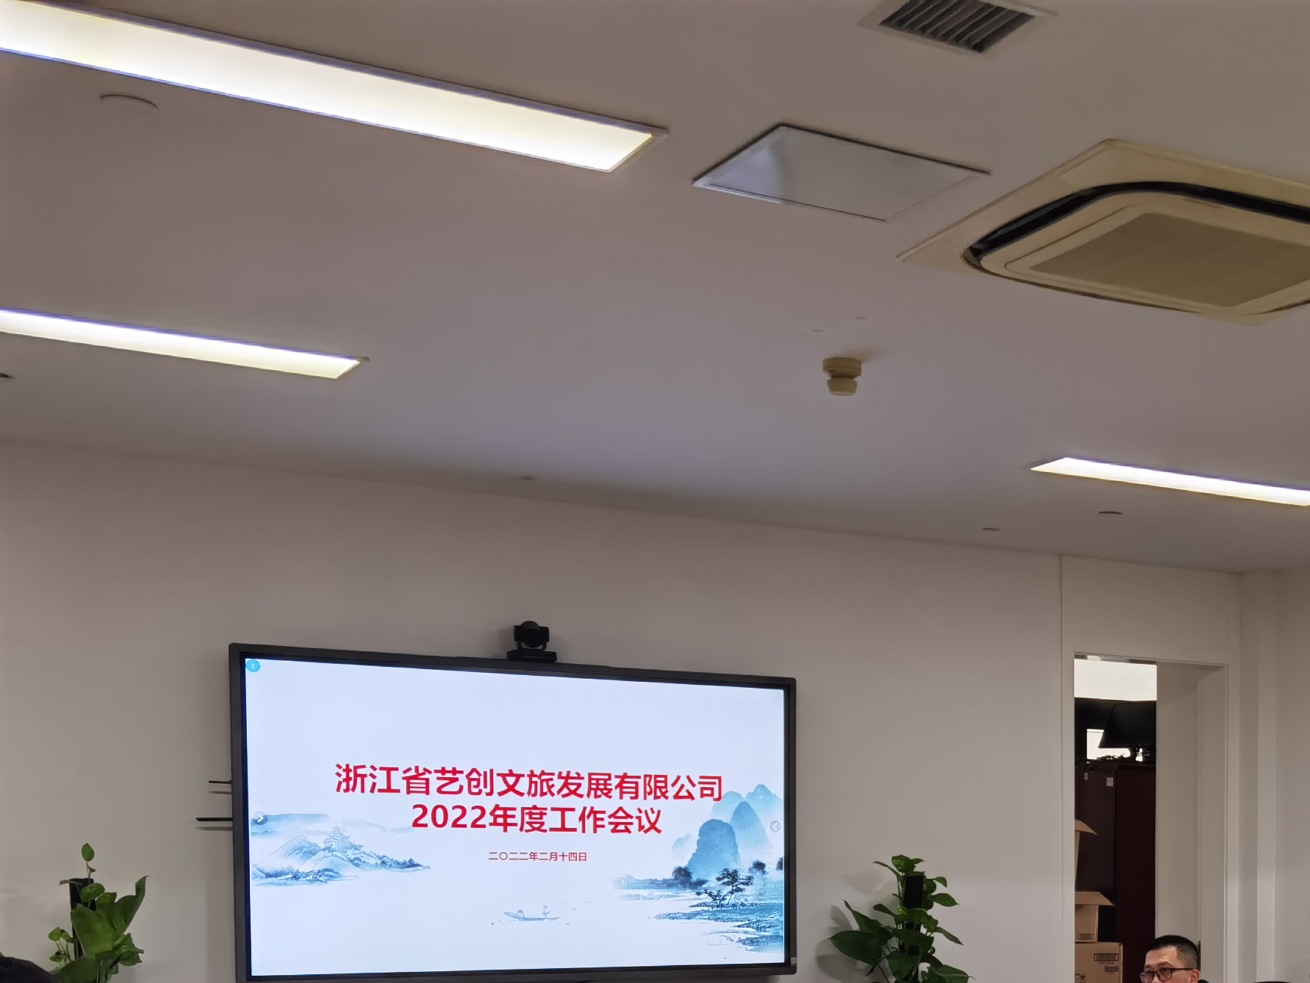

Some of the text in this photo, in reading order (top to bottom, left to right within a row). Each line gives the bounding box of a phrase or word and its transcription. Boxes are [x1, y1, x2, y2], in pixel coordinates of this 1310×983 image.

[334, 763, 724, 802] 浙江省艺创文旅发展有限公司
[411, 804, 662, 835] 2022年度工作会议
